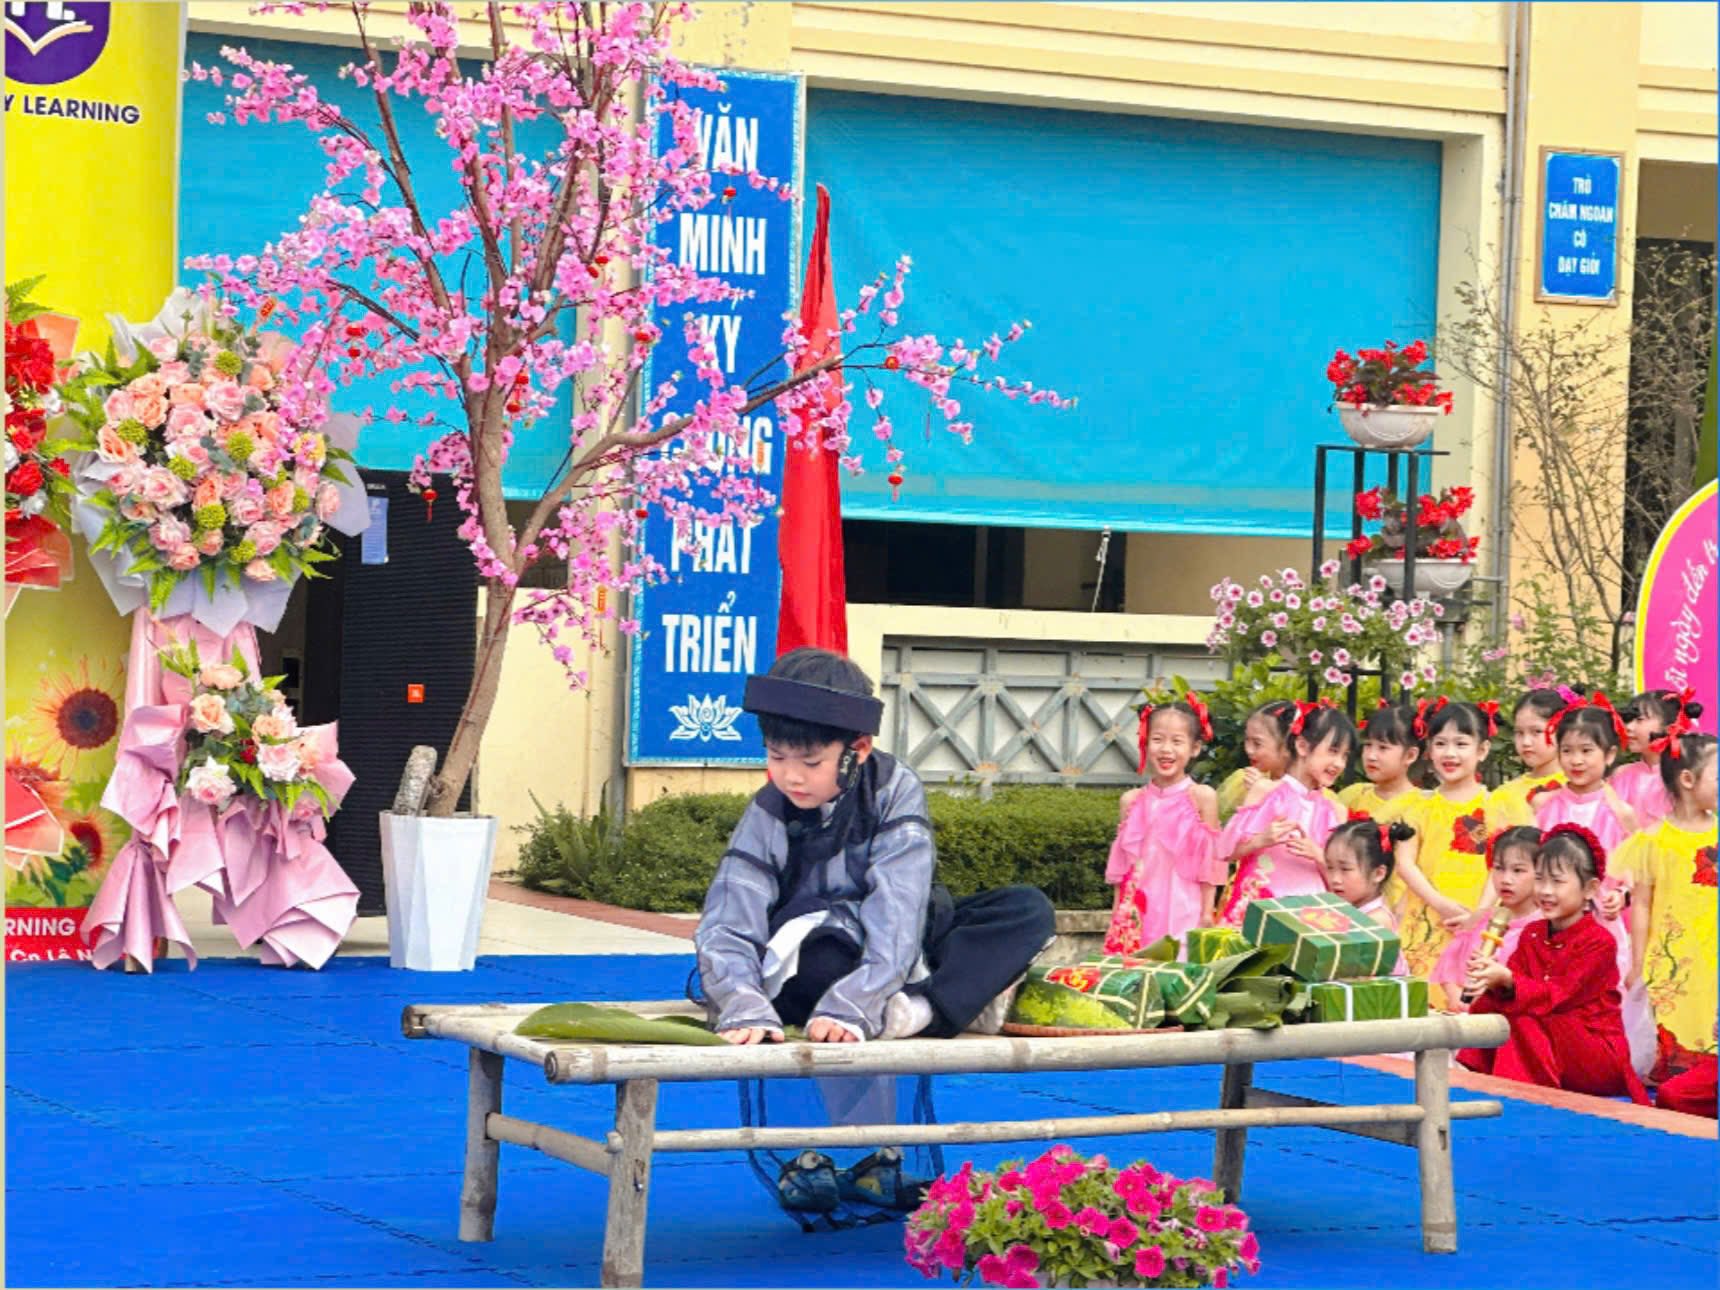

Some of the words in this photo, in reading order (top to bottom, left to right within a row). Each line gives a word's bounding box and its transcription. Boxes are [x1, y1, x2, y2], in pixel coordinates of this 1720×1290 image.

[23, 94, 140, 124] LEARNING
[1579, 204, 1614, 223] NGOAN
[679, 212, 767, 275] MINH
[661, 590, 757, 674] TRIỂN
